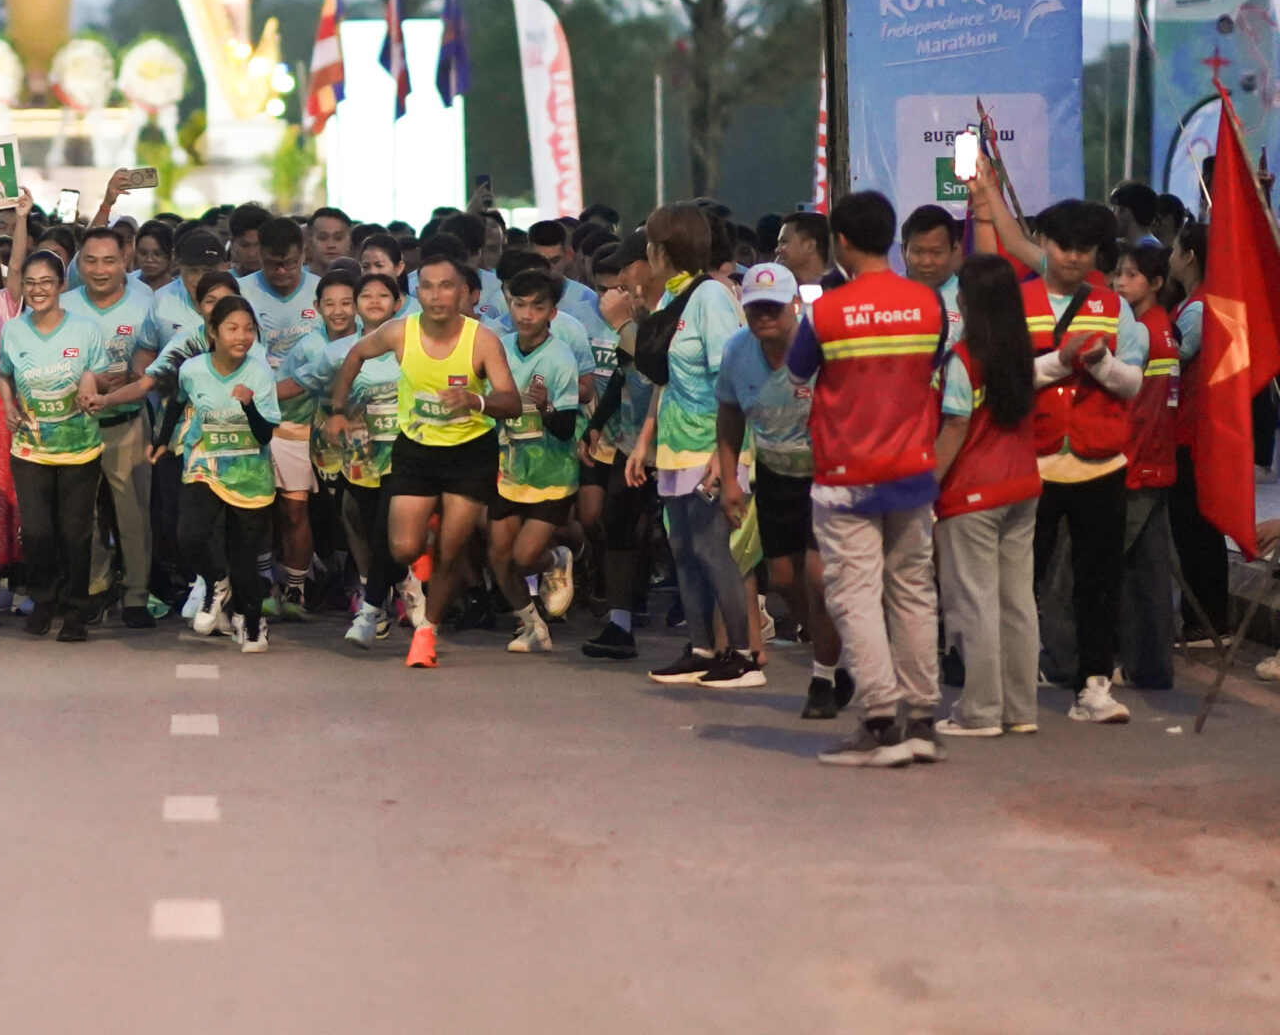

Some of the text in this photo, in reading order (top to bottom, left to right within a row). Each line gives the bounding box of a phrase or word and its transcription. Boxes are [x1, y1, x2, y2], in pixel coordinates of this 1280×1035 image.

[879, 3, 1021, 40] Independence Day
[915, 30, 998, 55] Marathon
[845, 308, 922, 327] SAI FORCE
[37, 401, 65, 413] 333
[209, 432, 239, 445] 550
